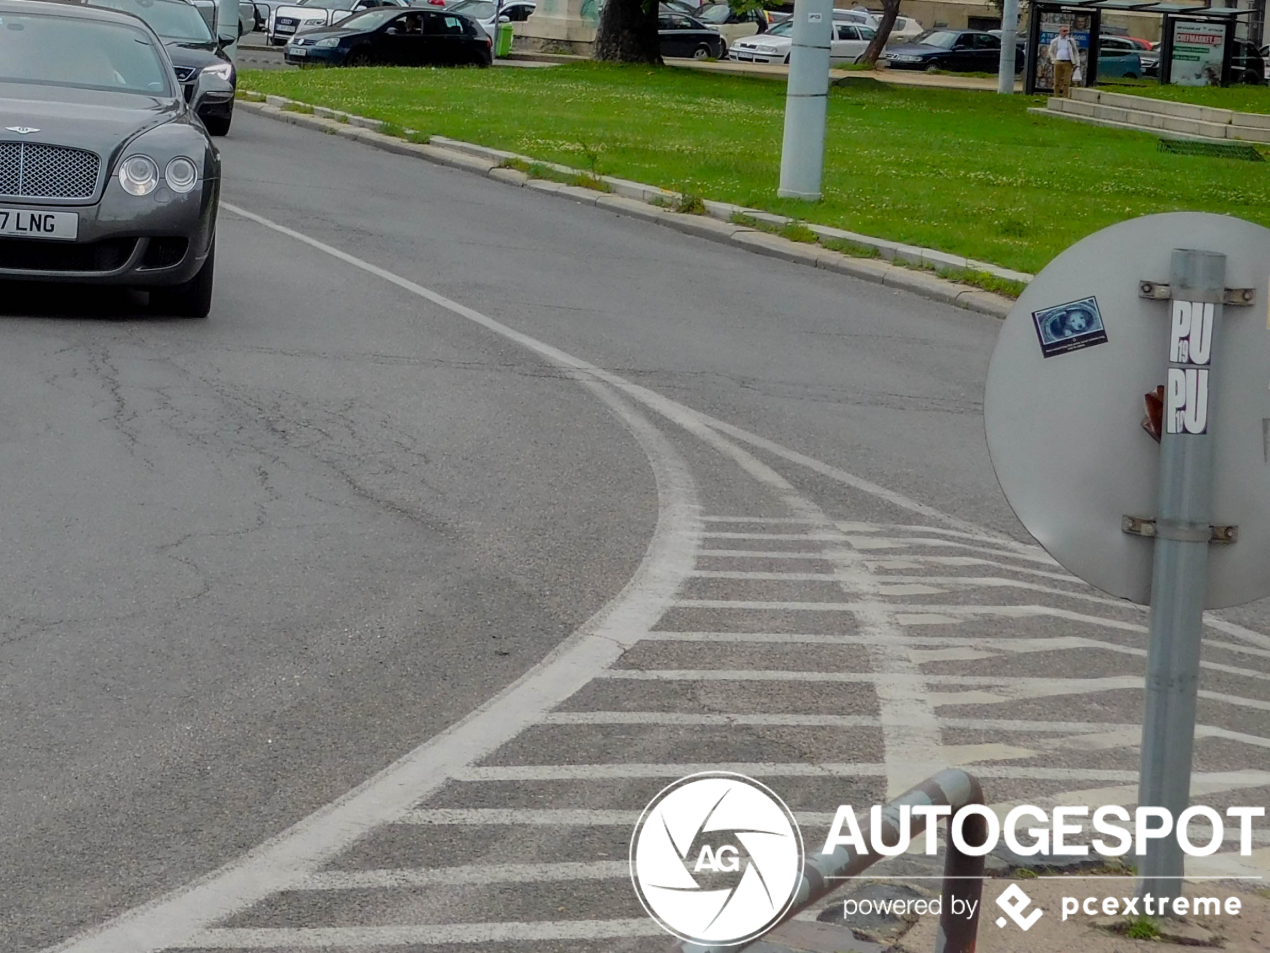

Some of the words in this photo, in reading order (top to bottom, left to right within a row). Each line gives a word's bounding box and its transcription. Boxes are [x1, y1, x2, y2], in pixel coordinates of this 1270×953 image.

[15, 212, 56, 233] LNG
[1169, 299, 1215, 365] PU
[1166, 368, 1209, 434] PU
